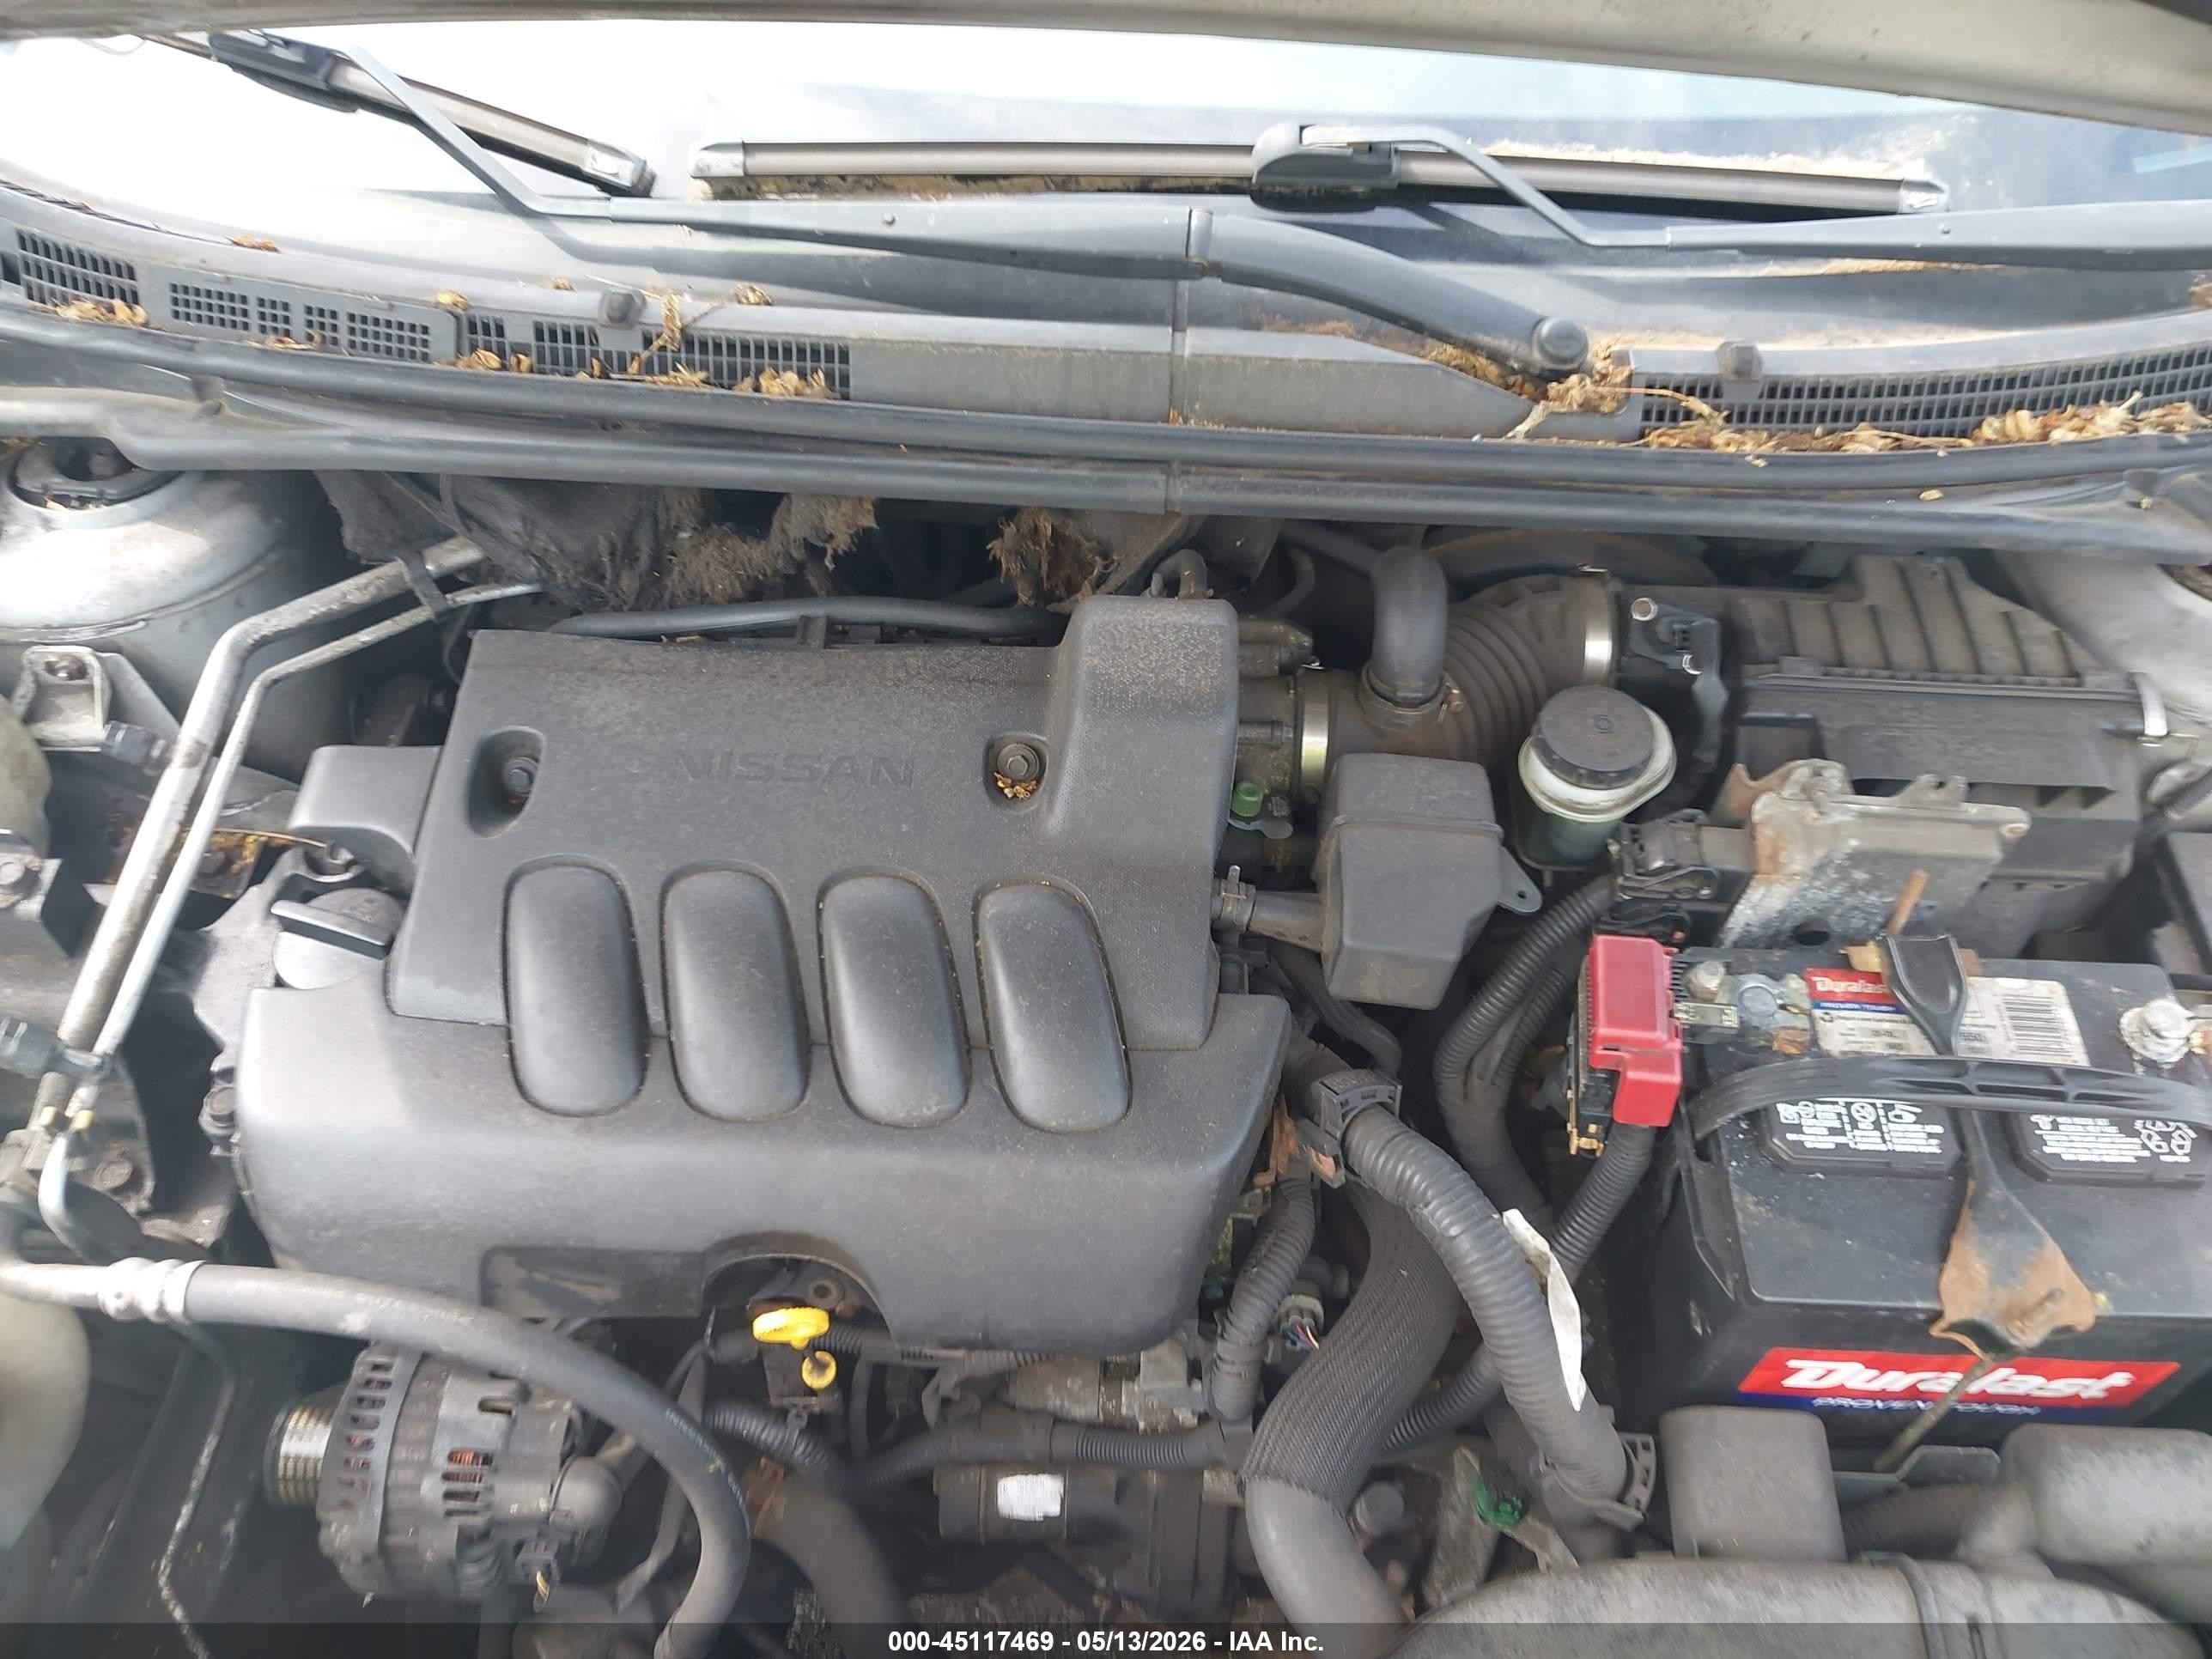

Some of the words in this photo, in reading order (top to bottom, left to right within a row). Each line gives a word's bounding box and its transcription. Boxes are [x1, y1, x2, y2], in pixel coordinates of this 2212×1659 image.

[675, 749, 915, 788] NISSAN
[1811, 976, 1889, 994] Duralas
[1780, 1358, 2136, 1400] Duralast
